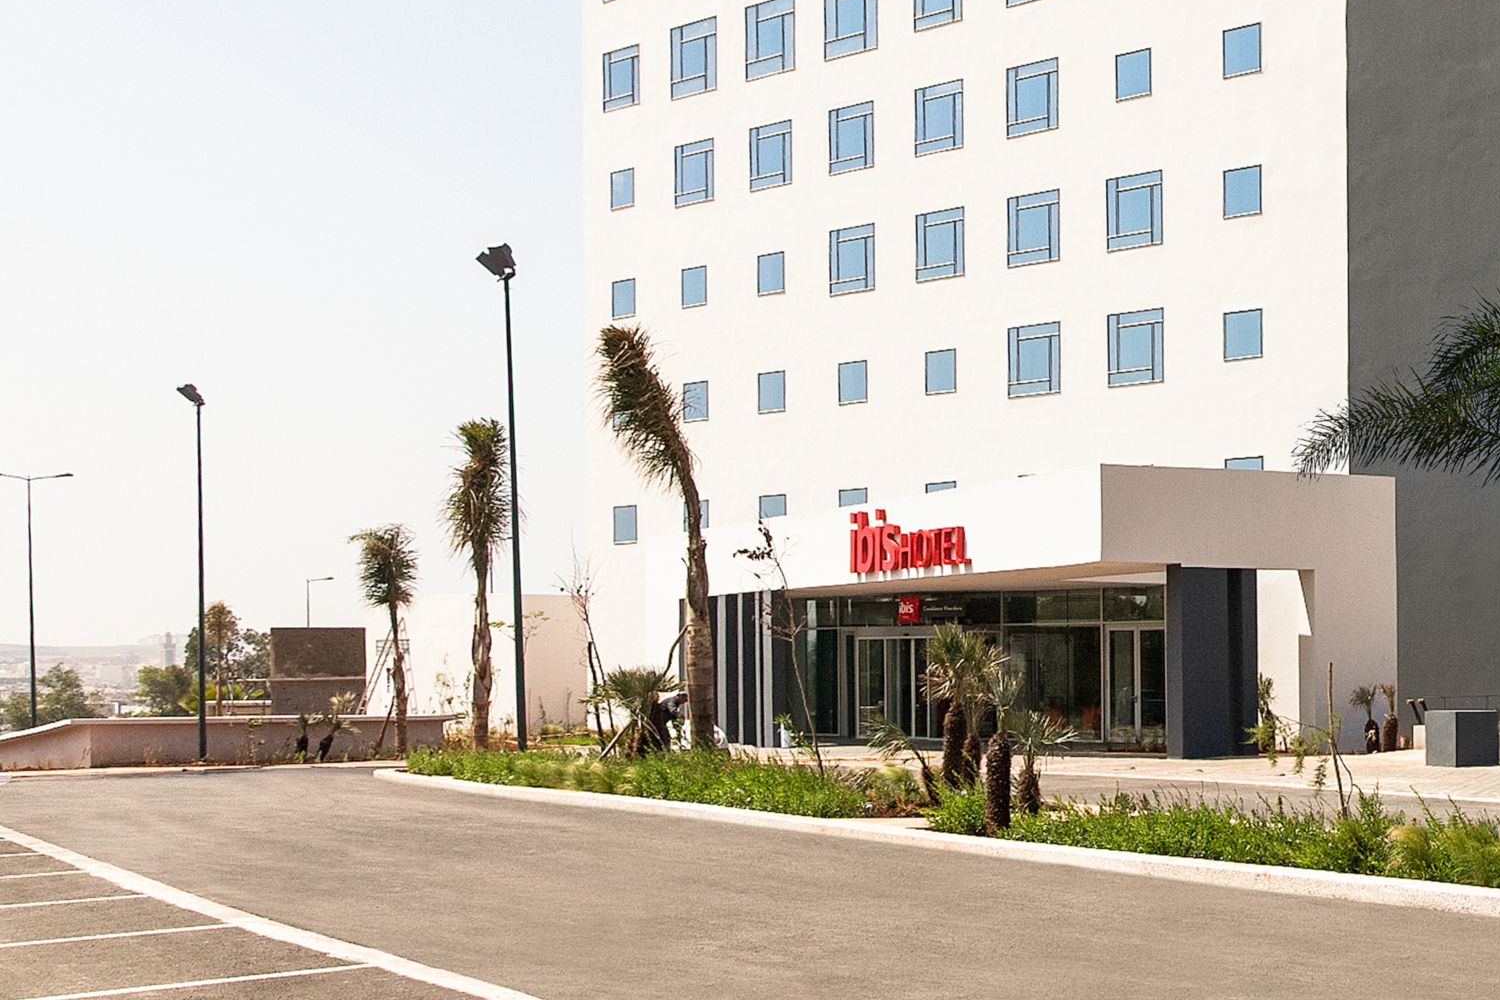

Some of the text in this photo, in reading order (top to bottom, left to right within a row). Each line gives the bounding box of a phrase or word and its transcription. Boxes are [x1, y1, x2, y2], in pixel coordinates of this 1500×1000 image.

[850, 509, 972, 573] ibis HOTEL
[898, 601, 914, 614] ibis
